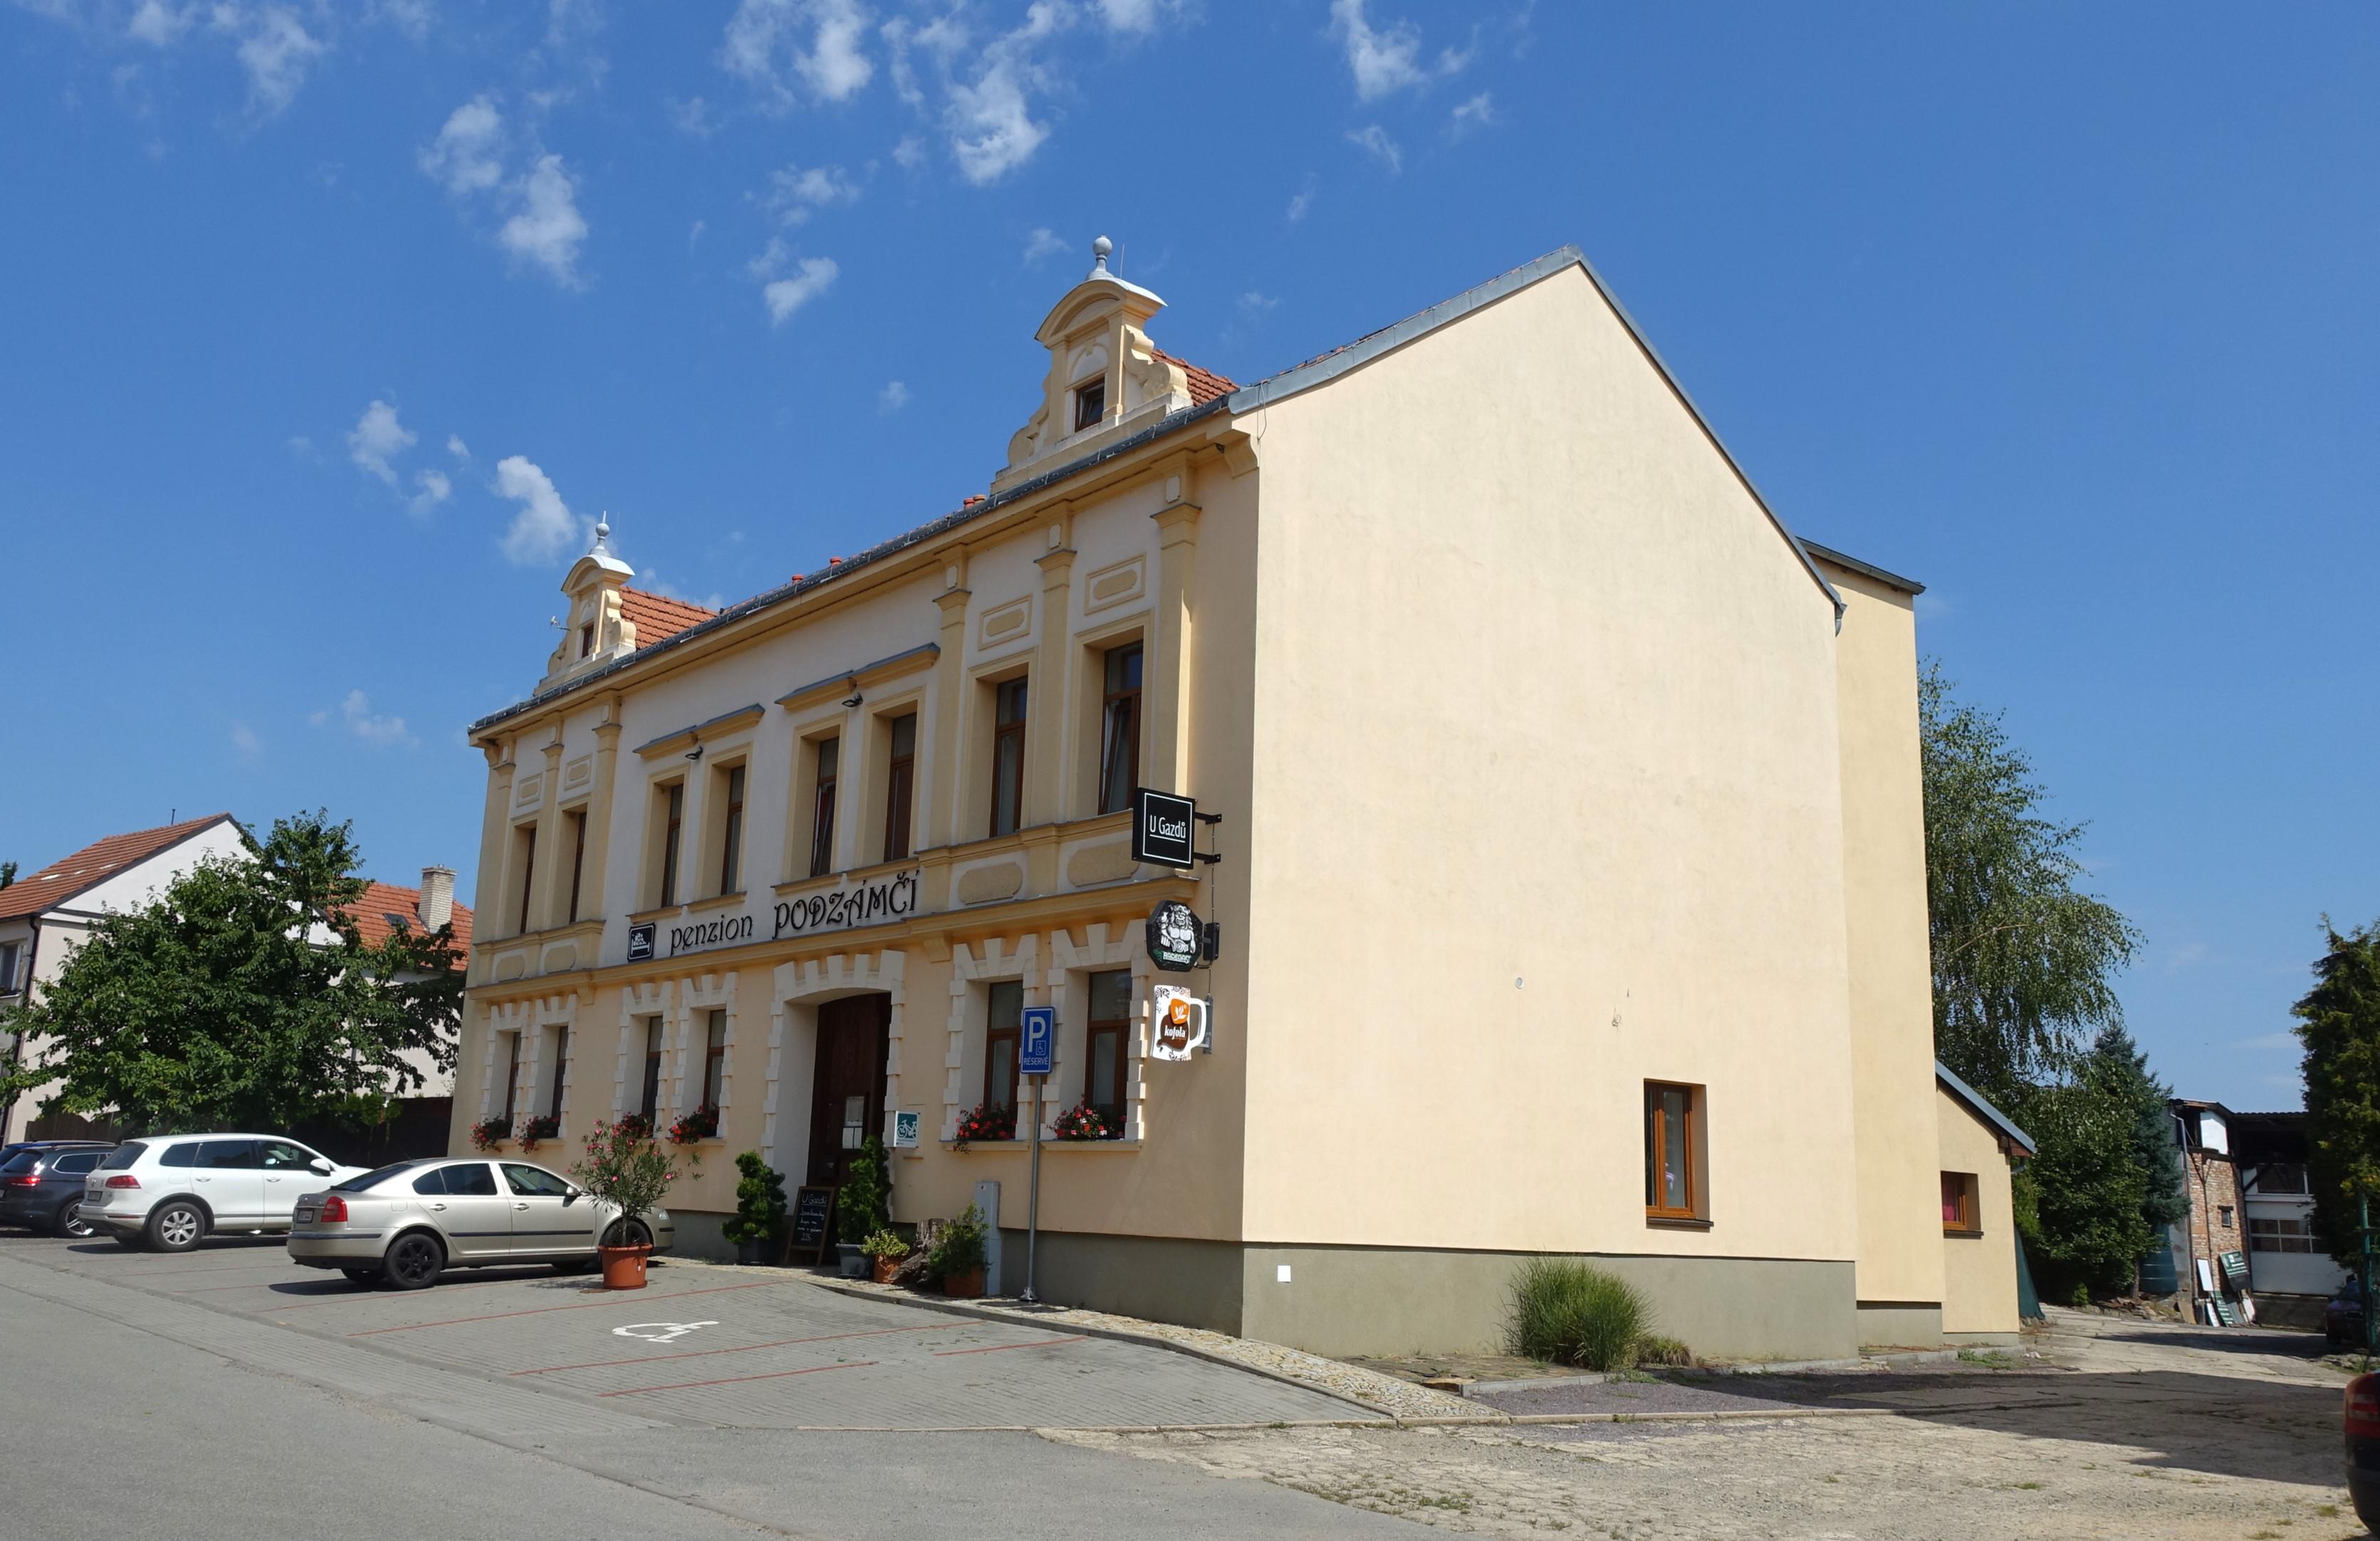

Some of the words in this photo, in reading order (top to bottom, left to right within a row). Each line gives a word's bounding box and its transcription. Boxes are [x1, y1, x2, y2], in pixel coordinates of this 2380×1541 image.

[1149, 815, 1157, 832] U
[1159, 817, 1186, 838] Gazdů
[671, 914, 753, 957] penzion
[772, 869, 920, 940] PODZÁMČÍ
[1162, 951, 1191, 964] RADEGAST
[1028, 1016, 1046, 1052] P
